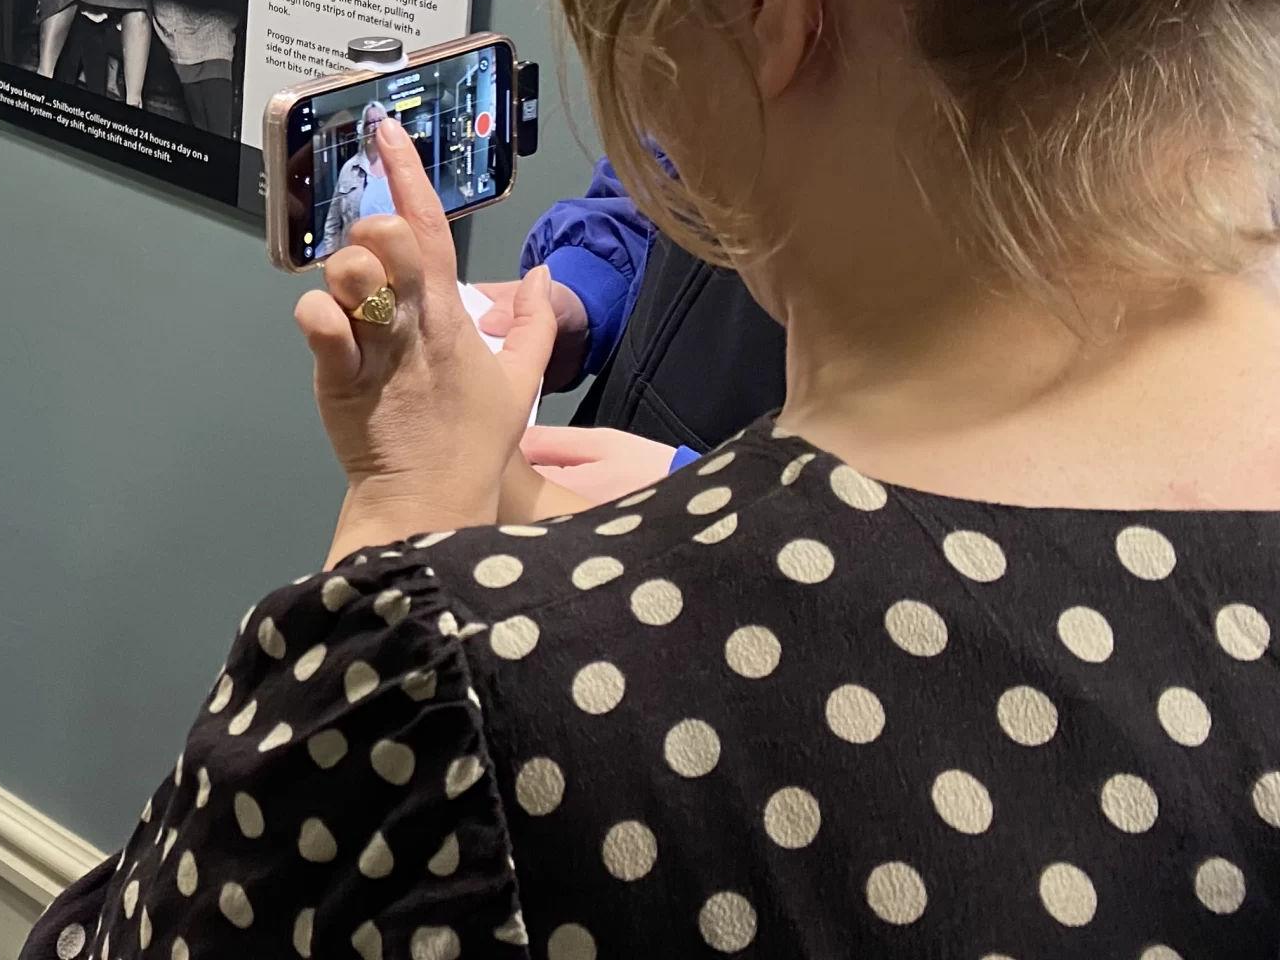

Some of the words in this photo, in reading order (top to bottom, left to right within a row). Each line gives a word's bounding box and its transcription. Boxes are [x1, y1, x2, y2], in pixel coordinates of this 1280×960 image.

[10, 86, 22, 96] you
[23, 89, 45, 104] know?
[53, 99, 84, 118] Shilbottle
[85, 111, 111, 129] Colliery
[112, 122, 138, 137] worked
[139, 130, 148, 140] 24
[149, 133, 170, 148] hours
[177, 144, 191, 157] day
[192, 151, 202, 160] on
[15, 100, 29, 111] shift
[30, 106, 52, 119] system
[57, 114, 69, 127] day
[70, 119, 86, 133] shift,
[88, 126, 106, 139] night
[107, 132, 122, 145] shift
[123, 140, 137, 150] and
[138, 143, 153, 156] fore
[154, 149, 172, 163] shift.
